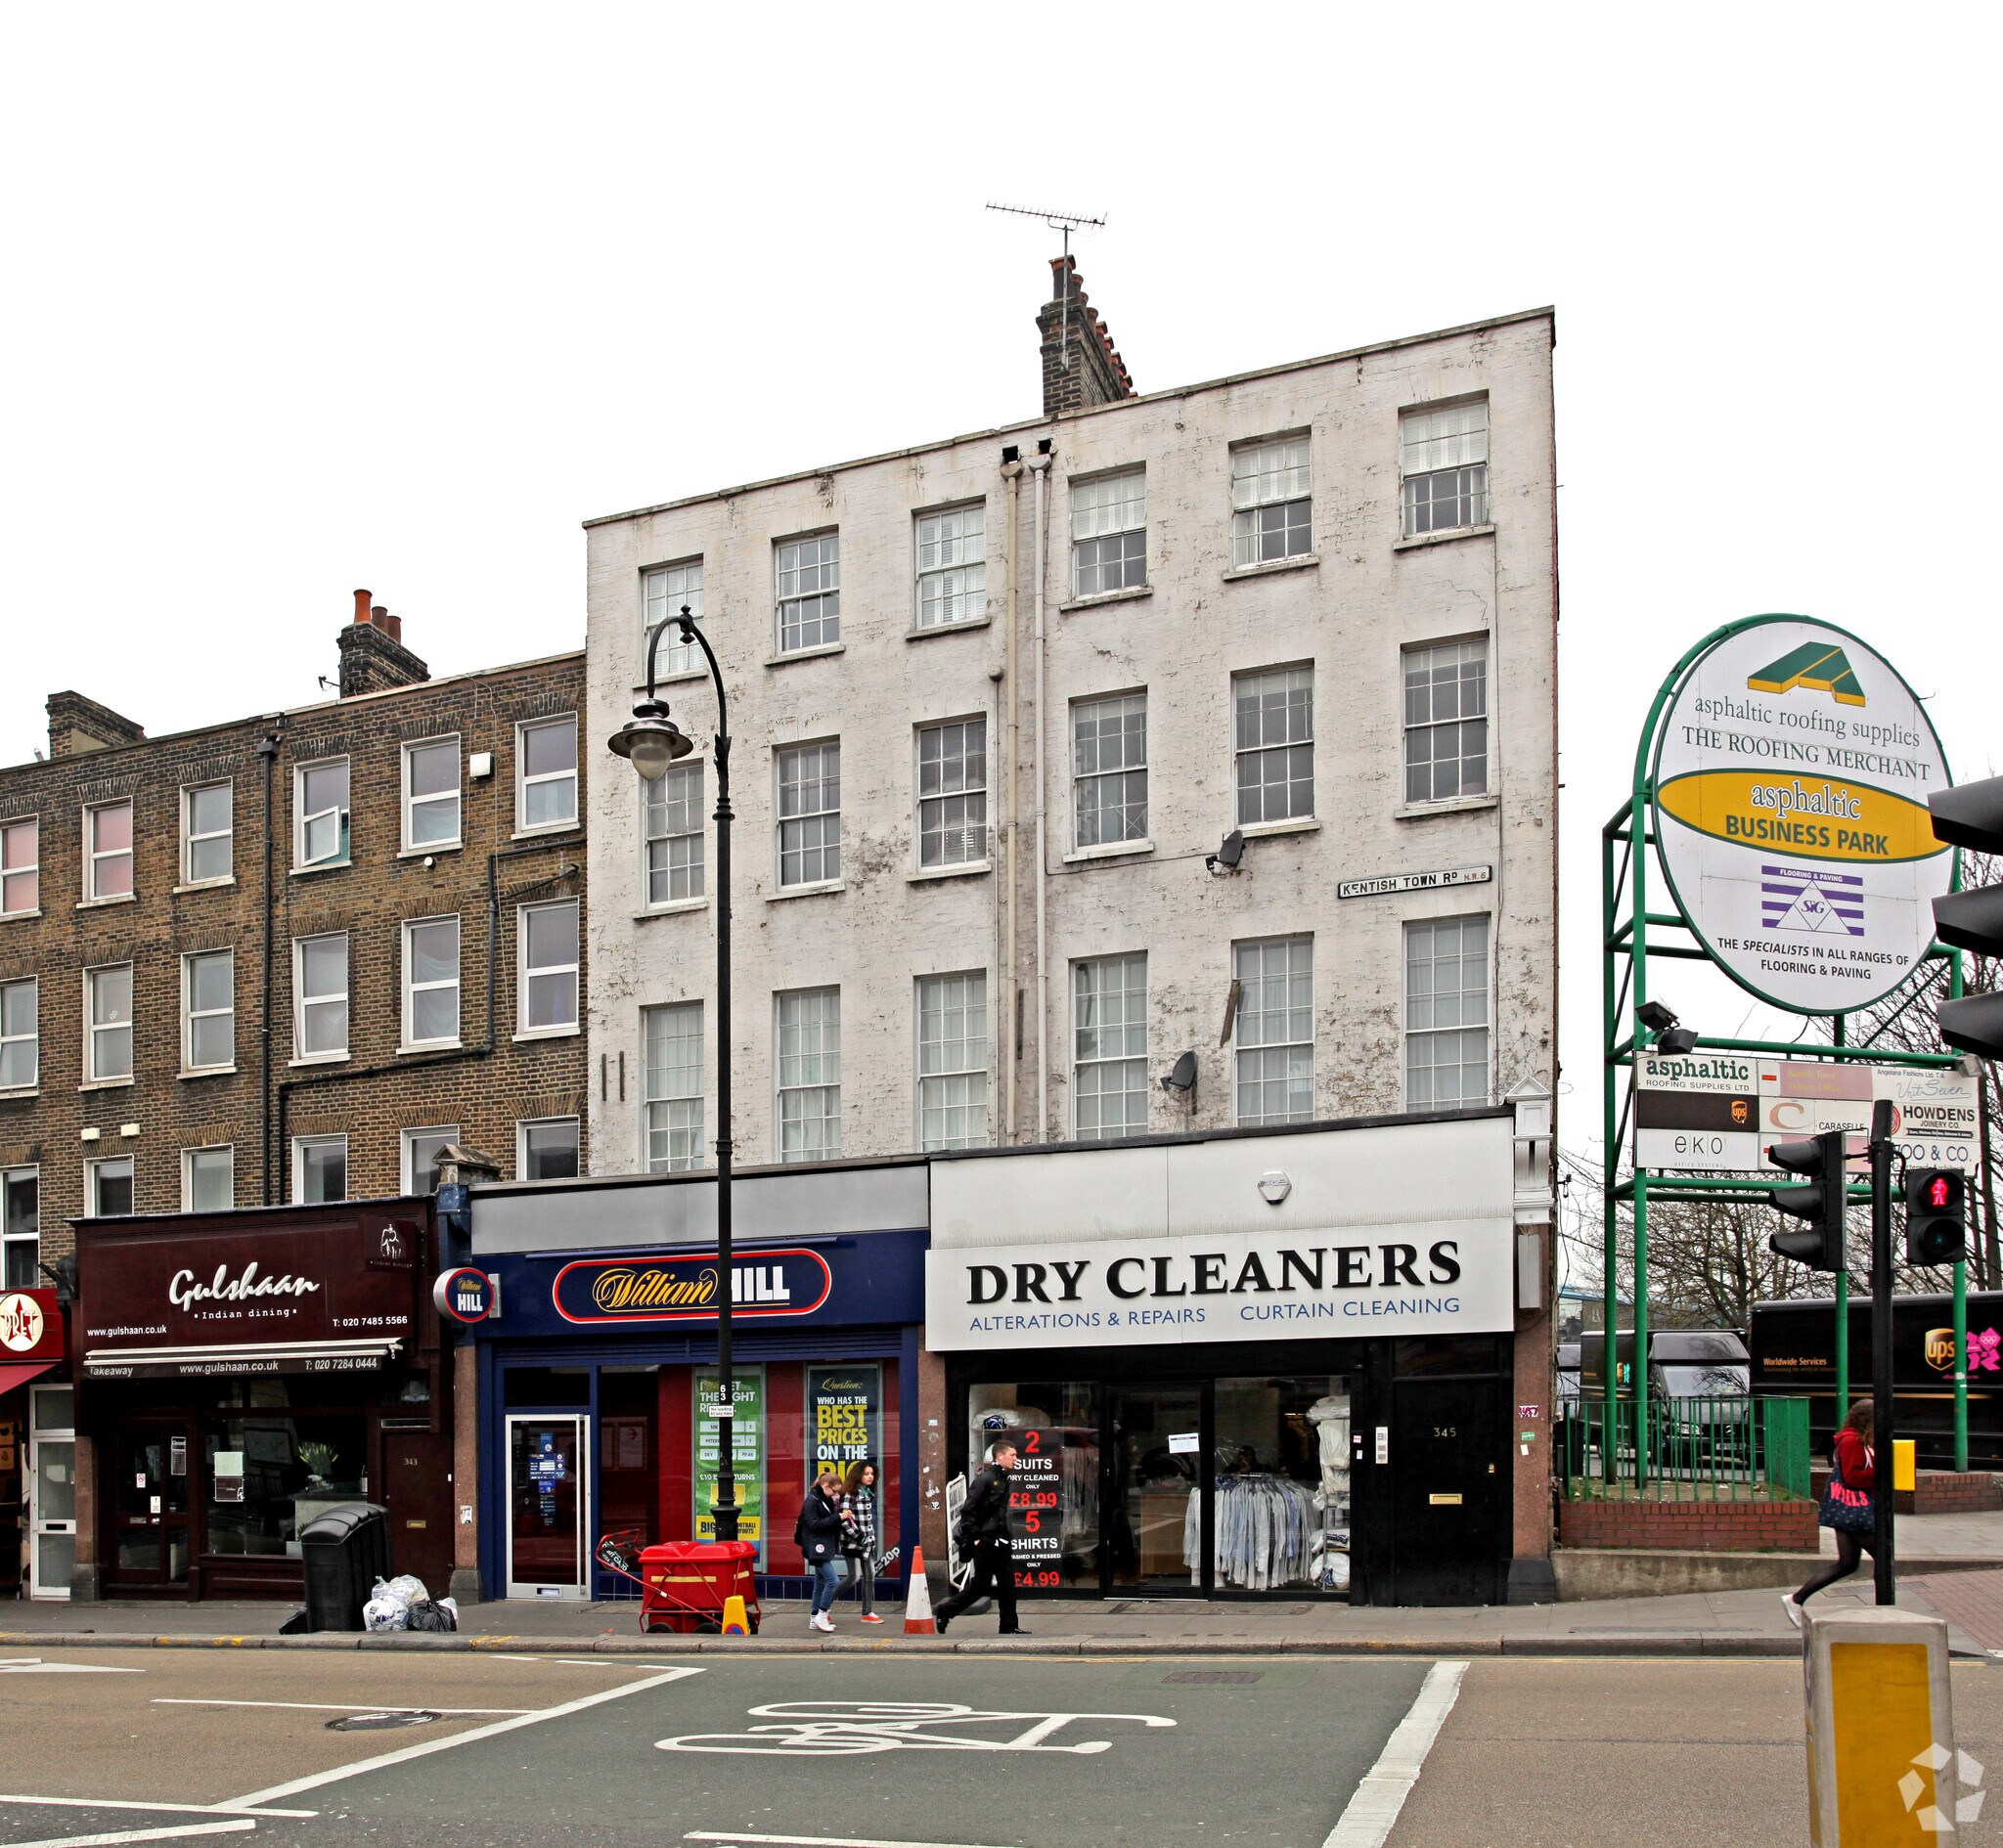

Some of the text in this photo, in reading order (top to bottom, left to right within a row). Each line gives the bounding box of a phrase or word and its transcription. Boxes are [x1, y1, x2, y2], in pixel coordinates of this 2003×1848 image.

[1695, 696, 1920, 747] asphaltic roofing supplies
[1682, 726, 1931, 780] THE ROOFING MERCHANT
[1751, 780, 1861, 819] asphaltic
[1725, 814, 1890, 856] BUSINESS PARK
[1780, 868, 1812, 879] FLOORING
[1343, 880, 1397, 895] KENTISH
[1402, 874, 1437, 888] TOWN
[1717, 937, 1909, 966] THE SPECIALISTS IN ALL RANGES OF
[1761, 959, 1871, 980] FLOORING & PAVING
[1646, 1058, 1749, 1081] asphaltic
[1646, 1079, 1686, 1088] ROOFING
[1690, 1081, 1731, 1090] SUPPLIES
[1733, 1108, 1746, 1121] ups
[1903, 1105, 1976, 1122] HOWDENS
[1819, 1122, 1864, 1131] CARASELLE
[1931, 1145, 1940, 1161] &
[1946, 1146, 1972, 1162] CO.
[966, 1240, 1461, 1304] DRY CLEANERS
[169, 1261, 320, 1311] Gulshaan
[592, 1267, 719, 1313] William
[457, 1294, 483, 1311] HILL
[201, 1308, 289, 1320] Indian dining
[342, 1318, 359, 1327] 020
[362, 1317, 383, 1326] 7485
[385, 1315, 408, 1325] 5566
[969, 1298, 1460, 1331] ALTERATIONS & REPAIRS CURTAIN CLEANING
[87, 1324, 167, 1339] www.gulshaan.co.uk
[1763, 1356, 1827, 1366] Worldwide Services
[1928, 1341, 1955, 1364] ups
[89, 1366, 134, 1378] Takeaway
[179, 1361, 279, 1376] www.gulshaan.co.uk
[305, 1357, 378, 1370] T: 020 7284 0444
[699, 1391, 756, 1402] THE GHT
[817, 1396, 835, 1405] WHO
[817, 1405, 868, 1428] BEST
[817, 1428, 868, 1445] PRICES
[1434, 1427, 1456, 1437] 345
[1025, 1430, 1041, 1454] 2
[817, 1445, 868, 1460] ON THE
[1013, 1458, 1053, 1470] SUITS
[1009, 1492, 1058, 1508] £8.99
[1025, 1511, 1041, 1533] 5
[1010, 1537, 1058, 1550] SHIRTS
[880, 1547, 900, 1566] 20p
[1014, 1571, 1060, 1587] £4.99
